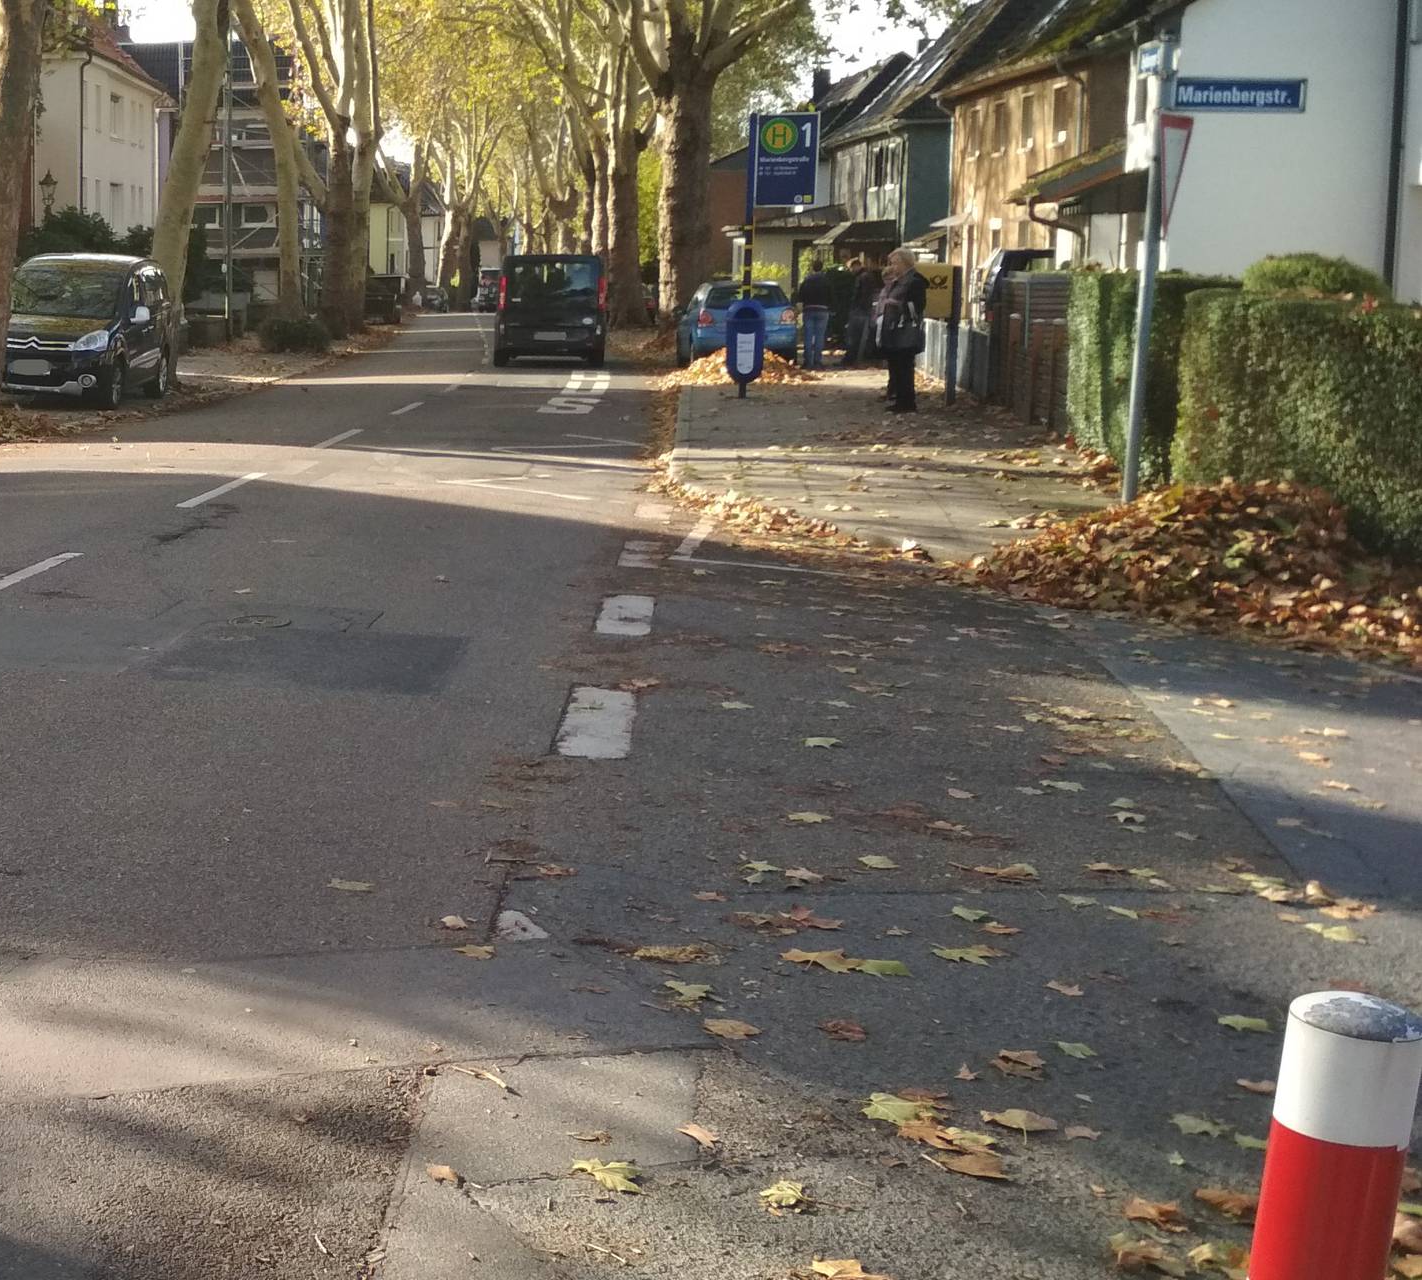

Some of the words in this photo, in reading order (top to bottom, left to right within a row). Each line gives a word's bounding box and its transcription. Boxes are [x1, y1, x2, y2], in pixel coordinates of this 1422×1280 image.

[1178, 85, 1291, 106] Marienbergstr.
[772, 126, 787, 146] H
[801, 122, 812, 147] 1
